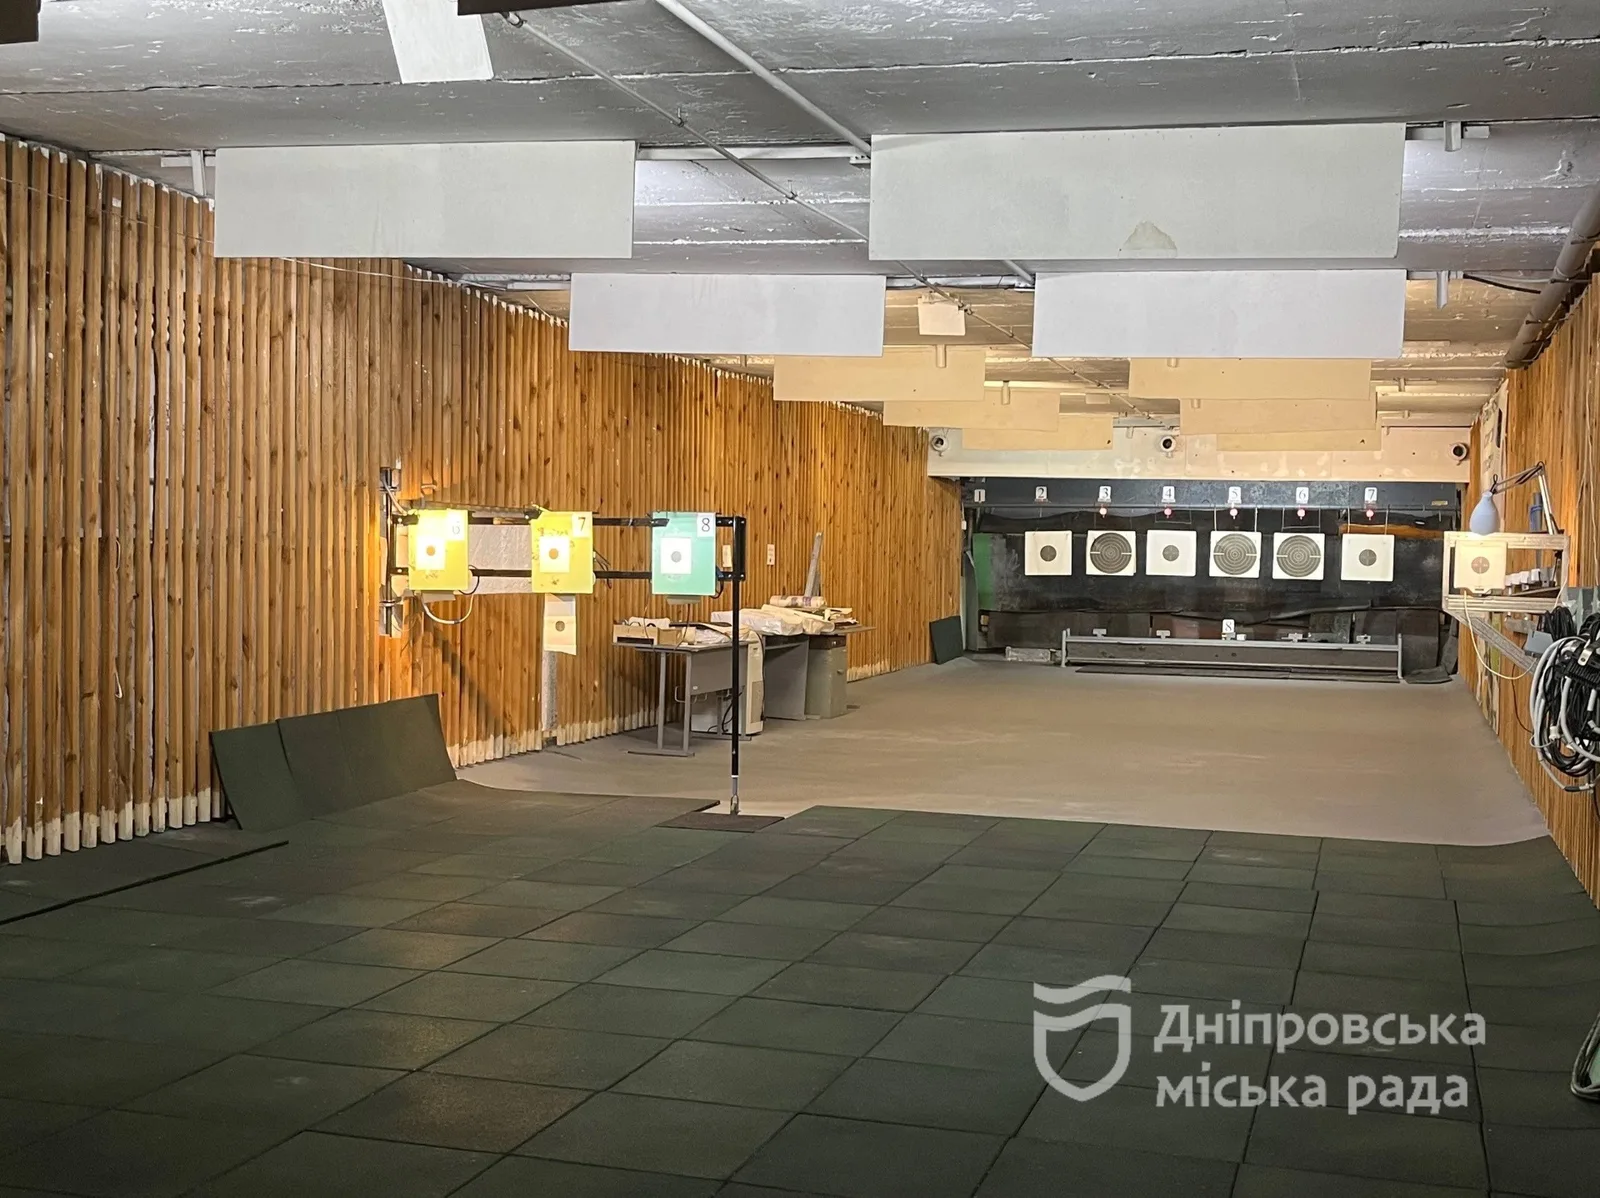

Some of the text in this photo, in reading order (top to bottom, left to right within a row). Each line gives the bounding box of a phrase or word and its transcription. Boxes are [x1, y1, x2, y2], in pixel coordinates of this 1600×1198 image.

[1038, 487, 1045, 498] 2
[1102, 487, 1109, 499] 3
[1165, 488, 1172, 498] 4
[1231, 487, 1238, 498] 5
[1299, 488, 1306, 499] 6
[1368, 489, 1375, 500] 7
[578, 517, 586, 532] 7
[701, 517, 711, 532] 8
[1224, 621, 1232, 632] 8
